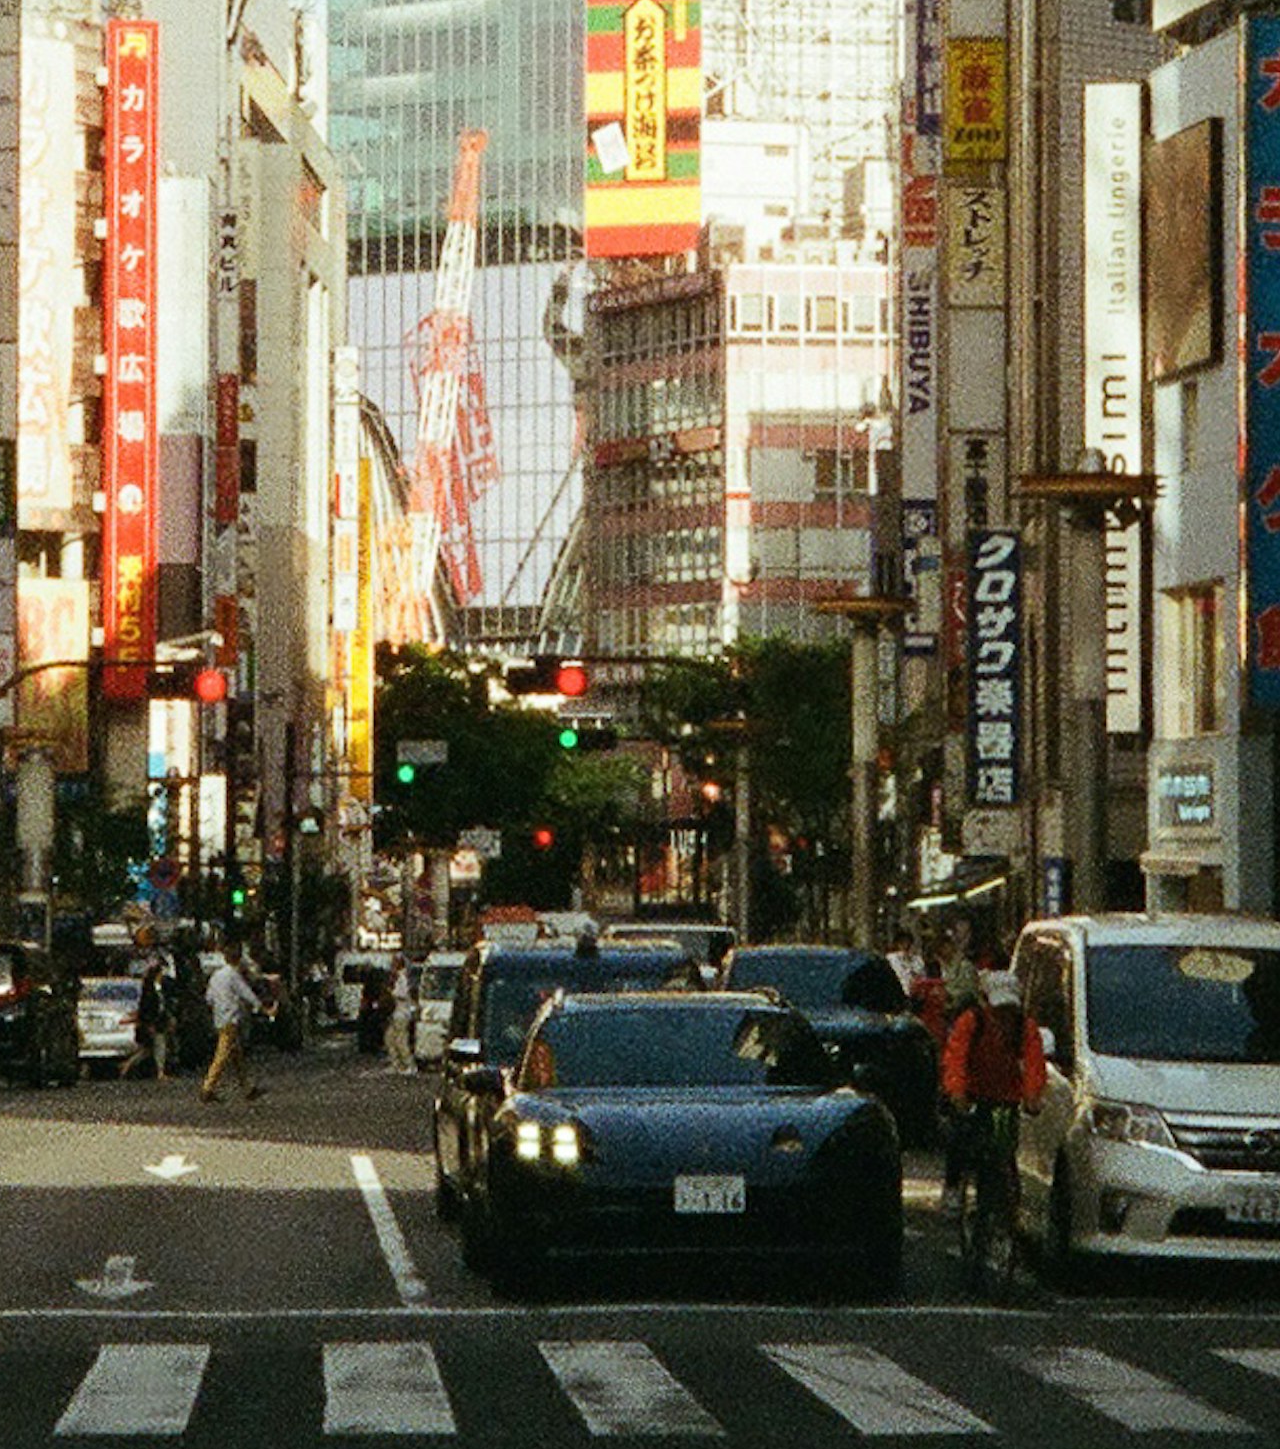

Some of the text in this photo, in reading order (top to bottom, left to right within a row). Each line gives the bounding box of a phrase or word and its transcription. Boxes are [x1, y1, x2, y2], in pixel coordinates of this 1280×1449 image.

[1106, 116, 1132, 219] lingerie
[964, 189, 992, 281] ストレッチ
[907, 271, 932, 415] SHIBUYA
[974, 533, 1016, 804] クロサワ楽器店
